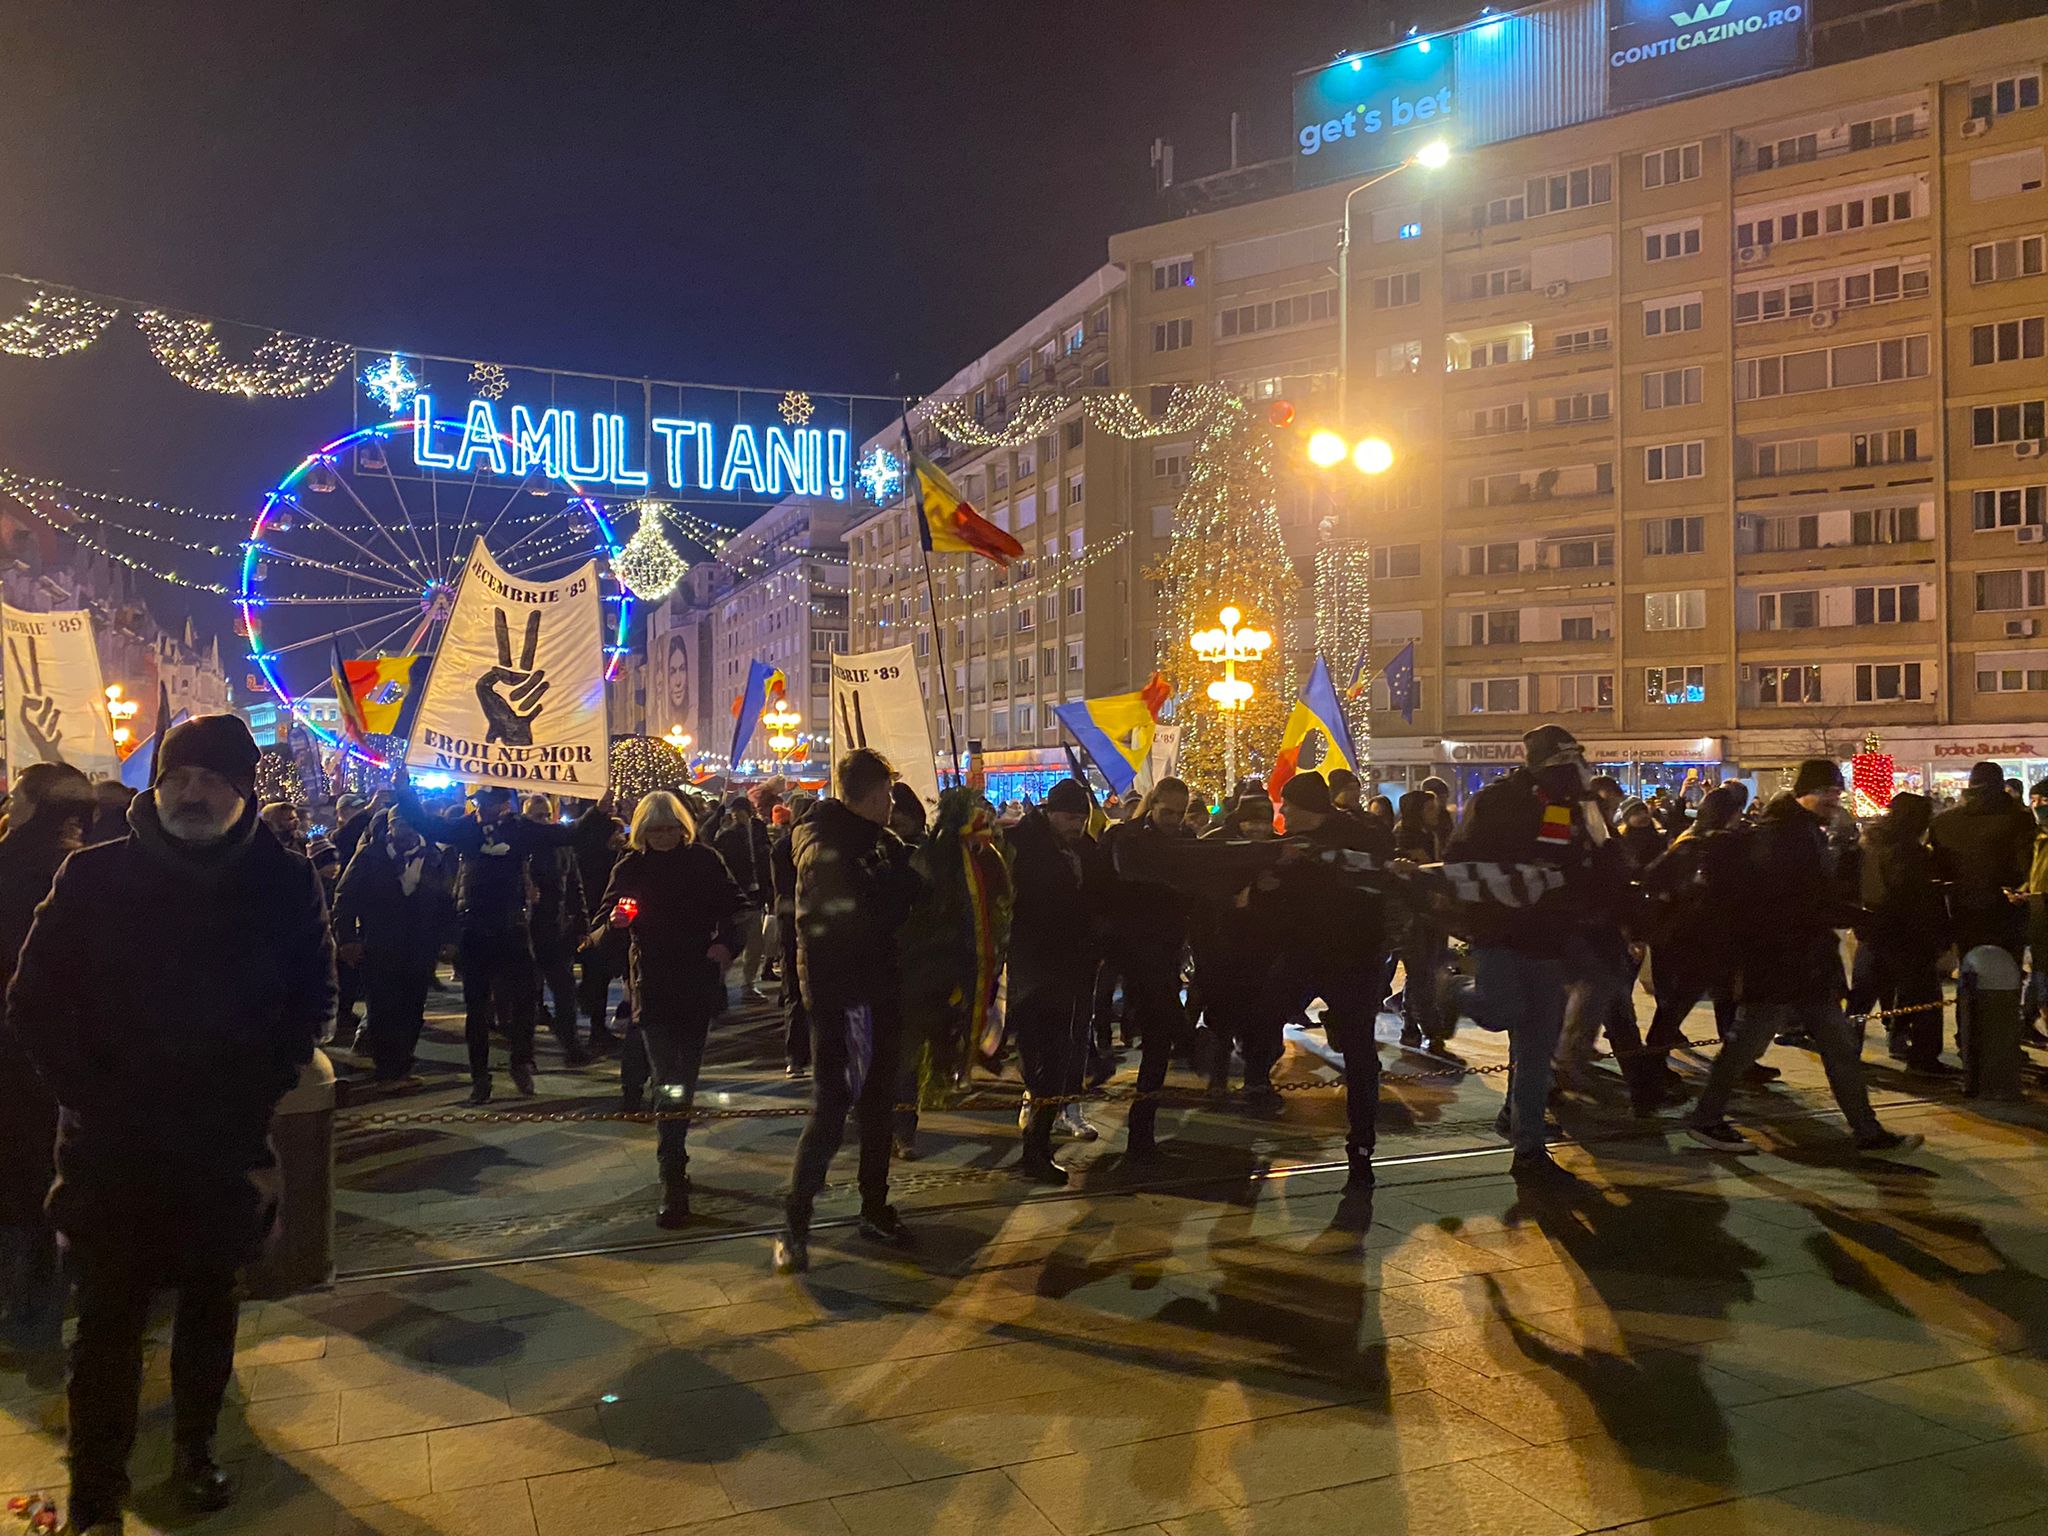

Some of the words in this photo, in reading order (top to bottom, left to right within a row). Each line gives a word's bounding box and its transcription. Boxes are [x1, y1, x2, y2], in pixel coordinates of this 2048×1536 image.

[1610, 5, 1802, 67] CONTICAZINO.RO
[1392, 86, 1451, 127] bet
[565, 577, 587, 597] '89
[52, 617, 82, 632] '89
[874, 666, 900, 680] '89
[424, 728, 489, 760] EROII
[498, 747, 530, 762] NU
[540, 745, 593, 763] MOR
[1452, 743, 1525, 760] CINEMA
[436, 752, 579, 782] NICIODATA
